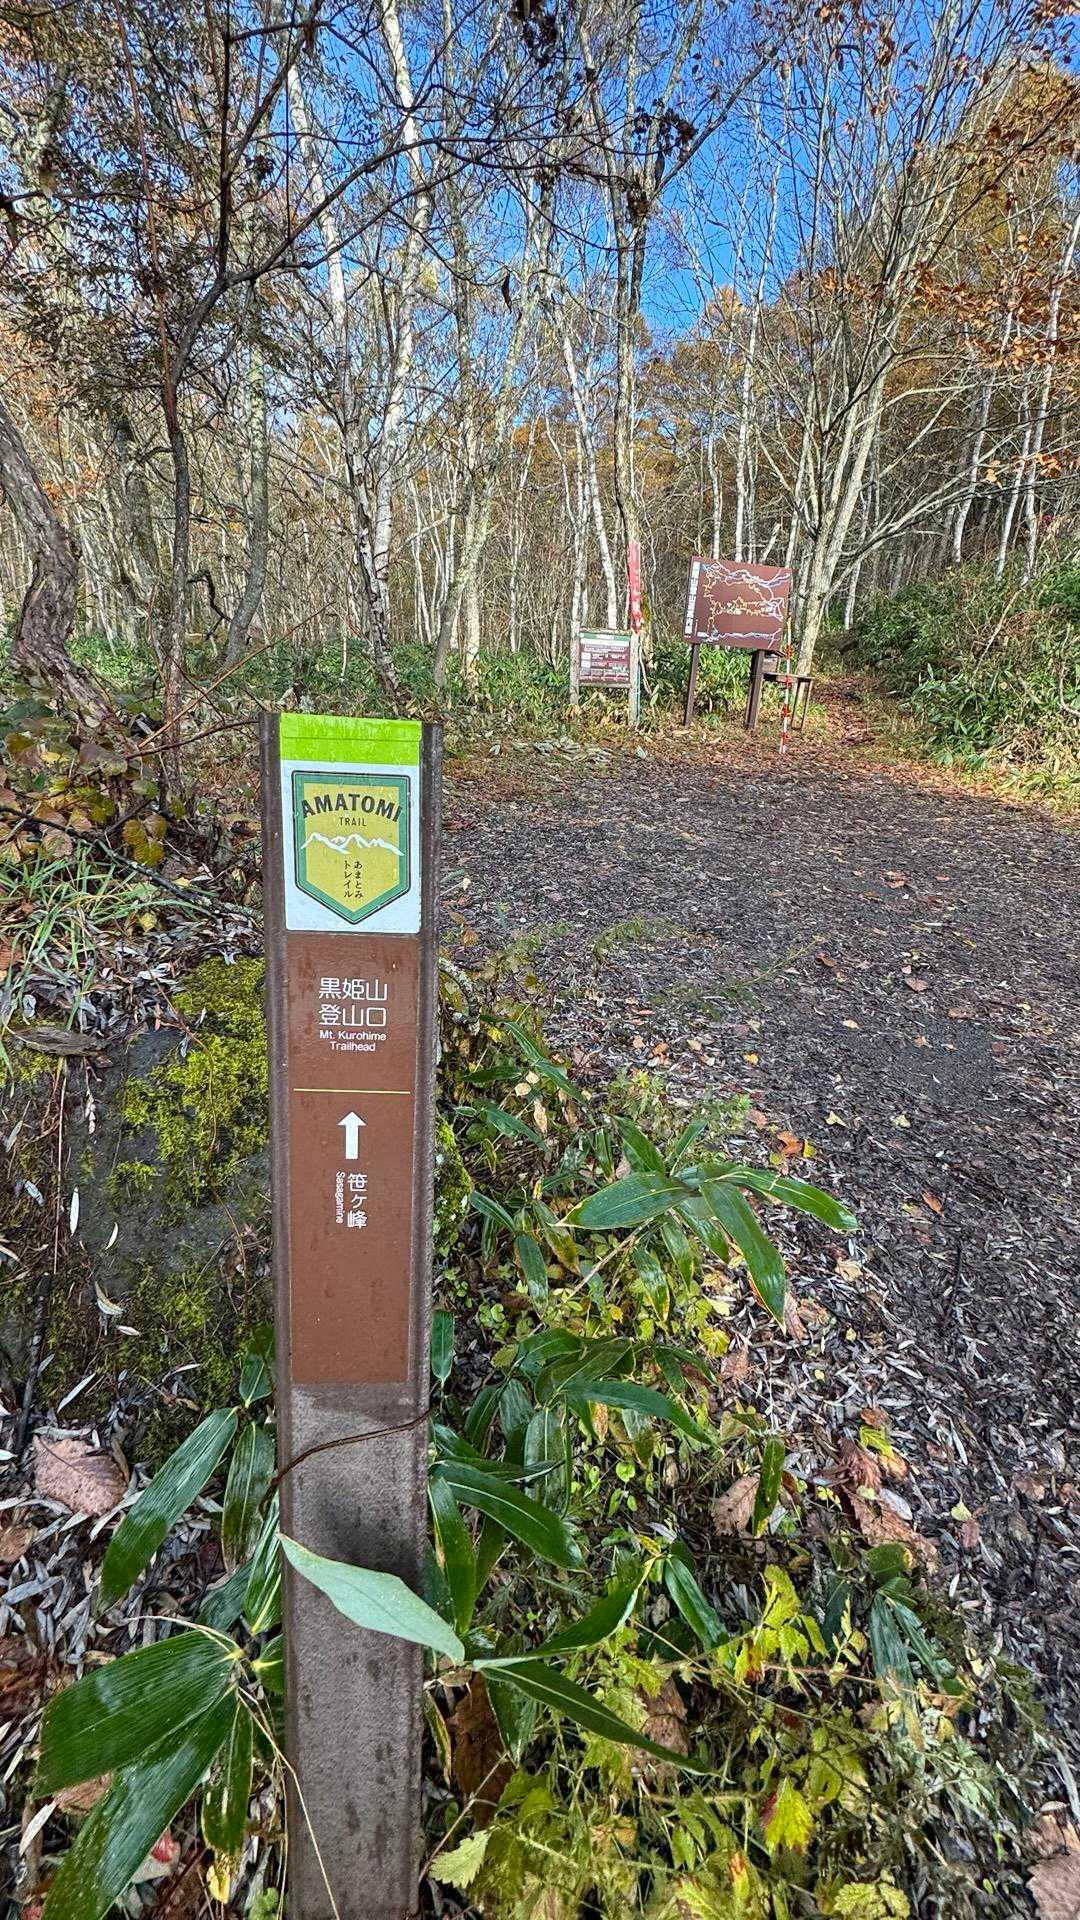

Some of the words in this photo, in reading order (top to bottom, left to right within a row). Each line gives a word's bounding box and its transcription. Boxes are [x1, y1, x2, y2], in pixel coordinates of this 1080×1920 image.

[301, 793, 403, 823] AMATOMI
[339, 816, 367, 827] TRAIL
[343, 860, 354, 898] トレイル
[354, 860, 364, 899] あまとみ
[318, 977, 388, 1001] 黒姫山
[318, 1003, 387, 1027] 登山口
[319, 1029, 336, 1040] Mt.
[338, 1030, 387, 1041] Kurohime
[329, 1041, 377, 1052] Trailhead
[335, 1170, 346, 1224] Sasagamine
